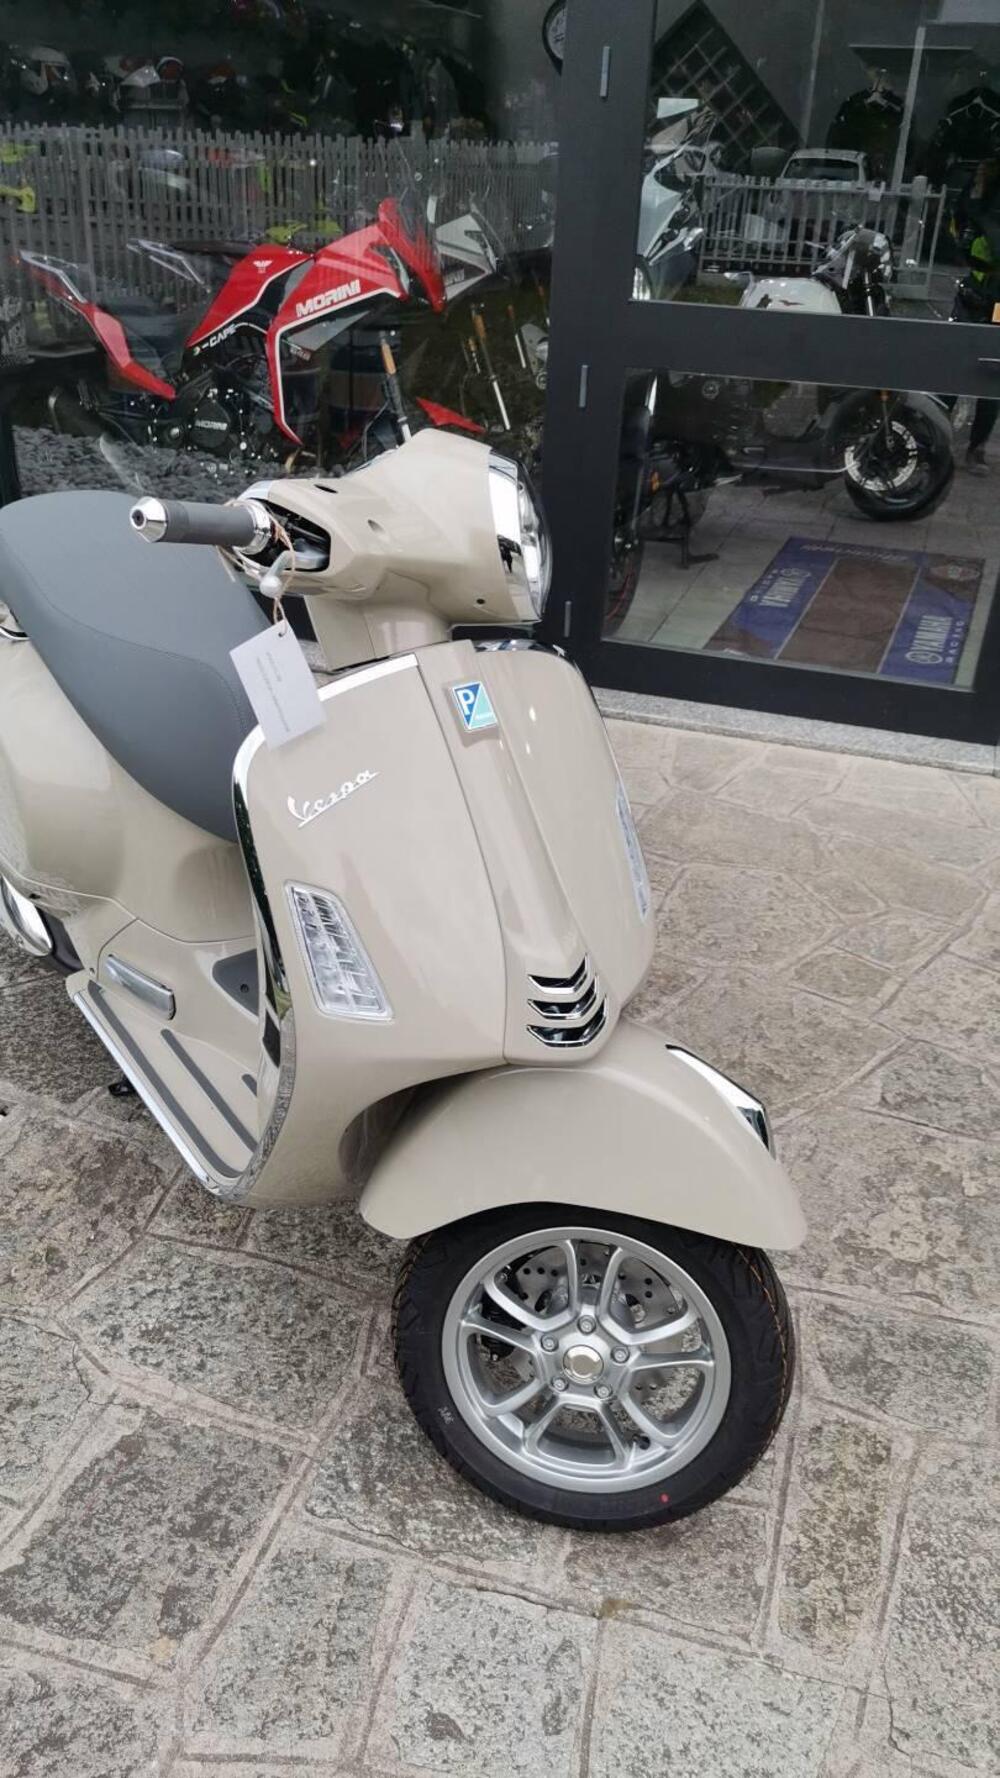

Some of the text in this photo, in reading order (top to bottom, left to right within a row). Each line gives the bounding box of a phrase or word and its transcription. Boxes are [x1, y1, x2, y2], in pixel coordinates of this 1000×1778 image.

[295, 279, 361, 318] MORINI
[910, 615, 953, 653] YAMAHA
[286, 769, 382, 829] Vespa
